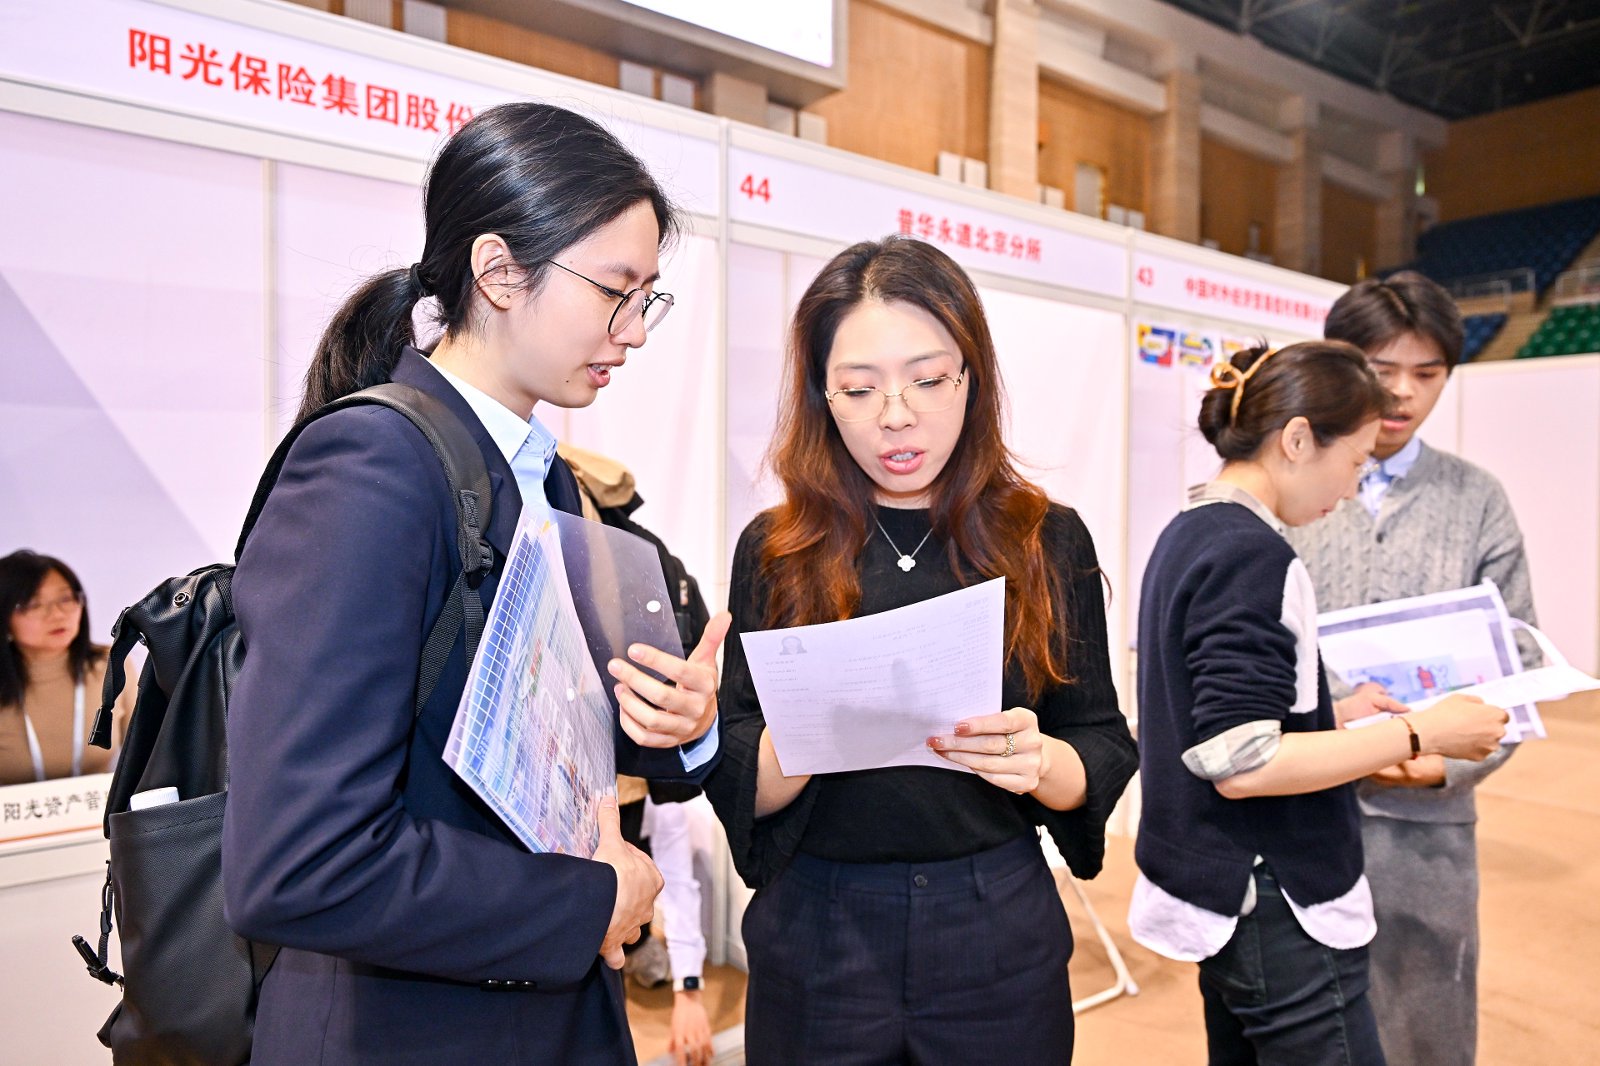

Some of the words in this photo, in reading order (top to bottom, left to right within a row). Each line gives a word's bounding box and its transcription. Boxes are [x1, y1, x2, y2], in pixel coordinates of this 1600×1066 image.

[740, 174, 772, 202] 44
[4, 791, 109, 821] 阳光资产管
